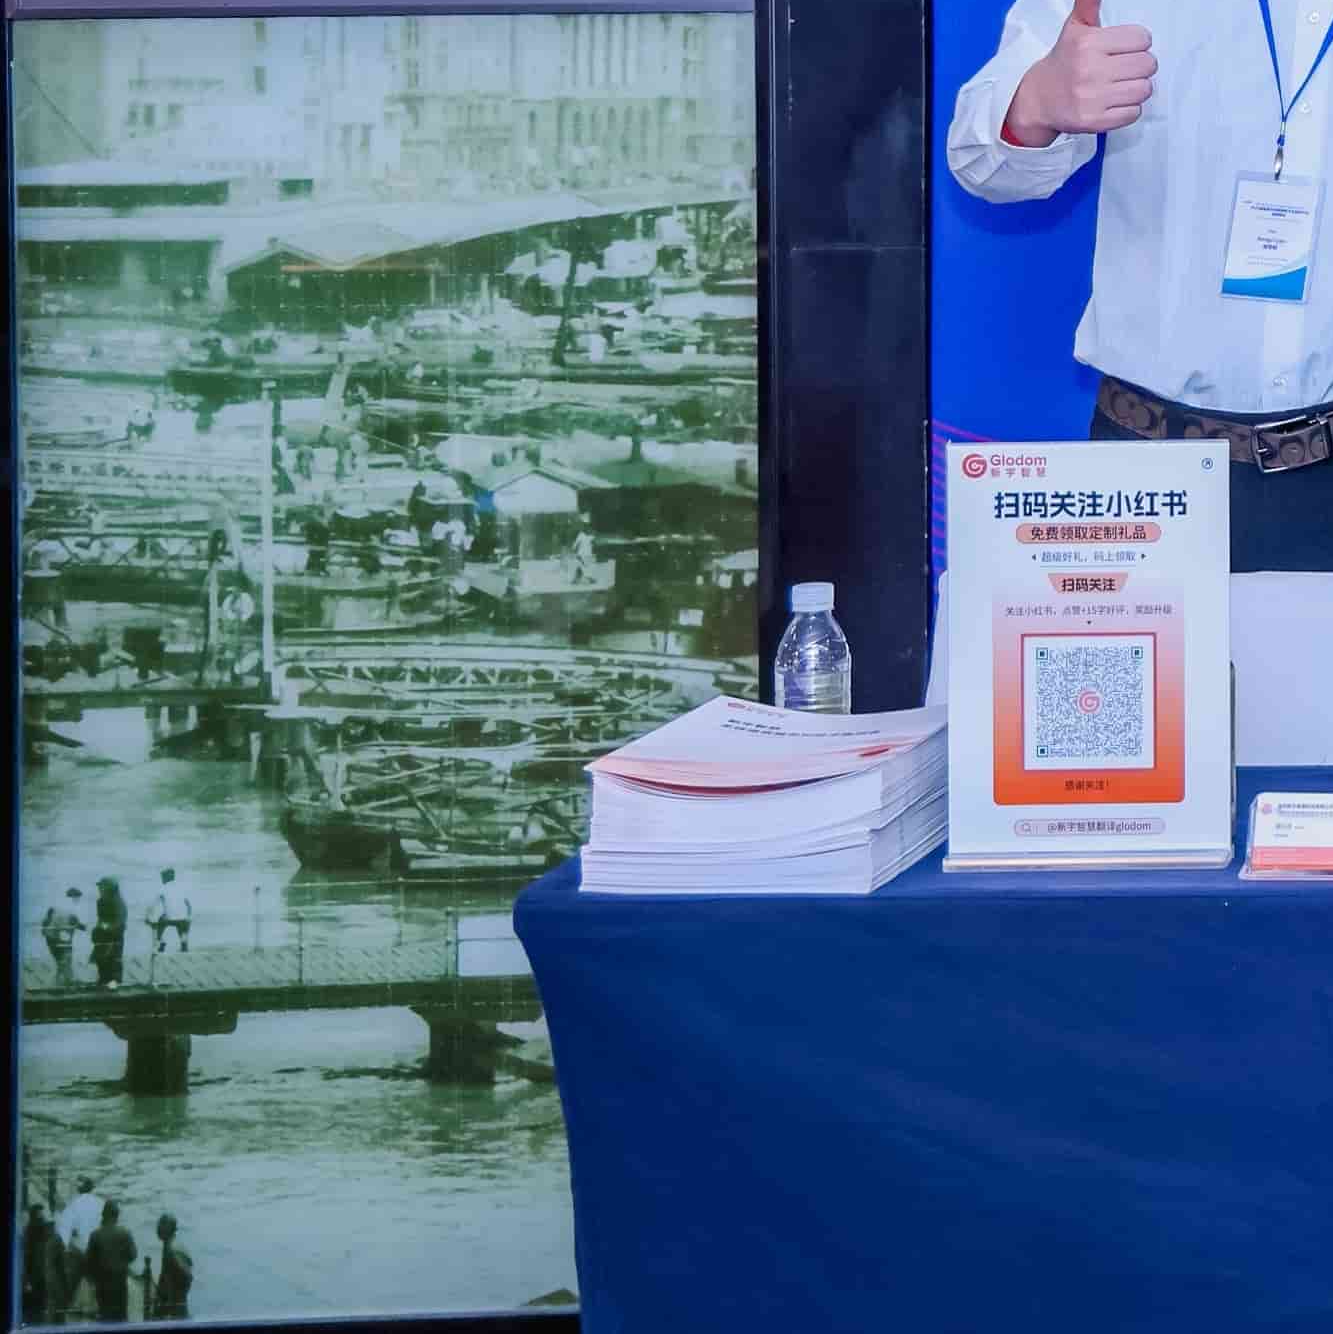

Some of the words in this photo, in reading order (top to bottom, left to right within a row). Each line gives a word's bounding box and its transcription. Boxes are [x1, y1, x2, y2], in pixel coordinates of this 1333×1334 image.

[990, 454, 1047, 467] Glodom
[994, 489, 1188, 519] 扫码关注小红书
[1031, 525, 1147, 541] 免费领取定制礼品
[1061, 578, 1116, 592] 扫码关注
